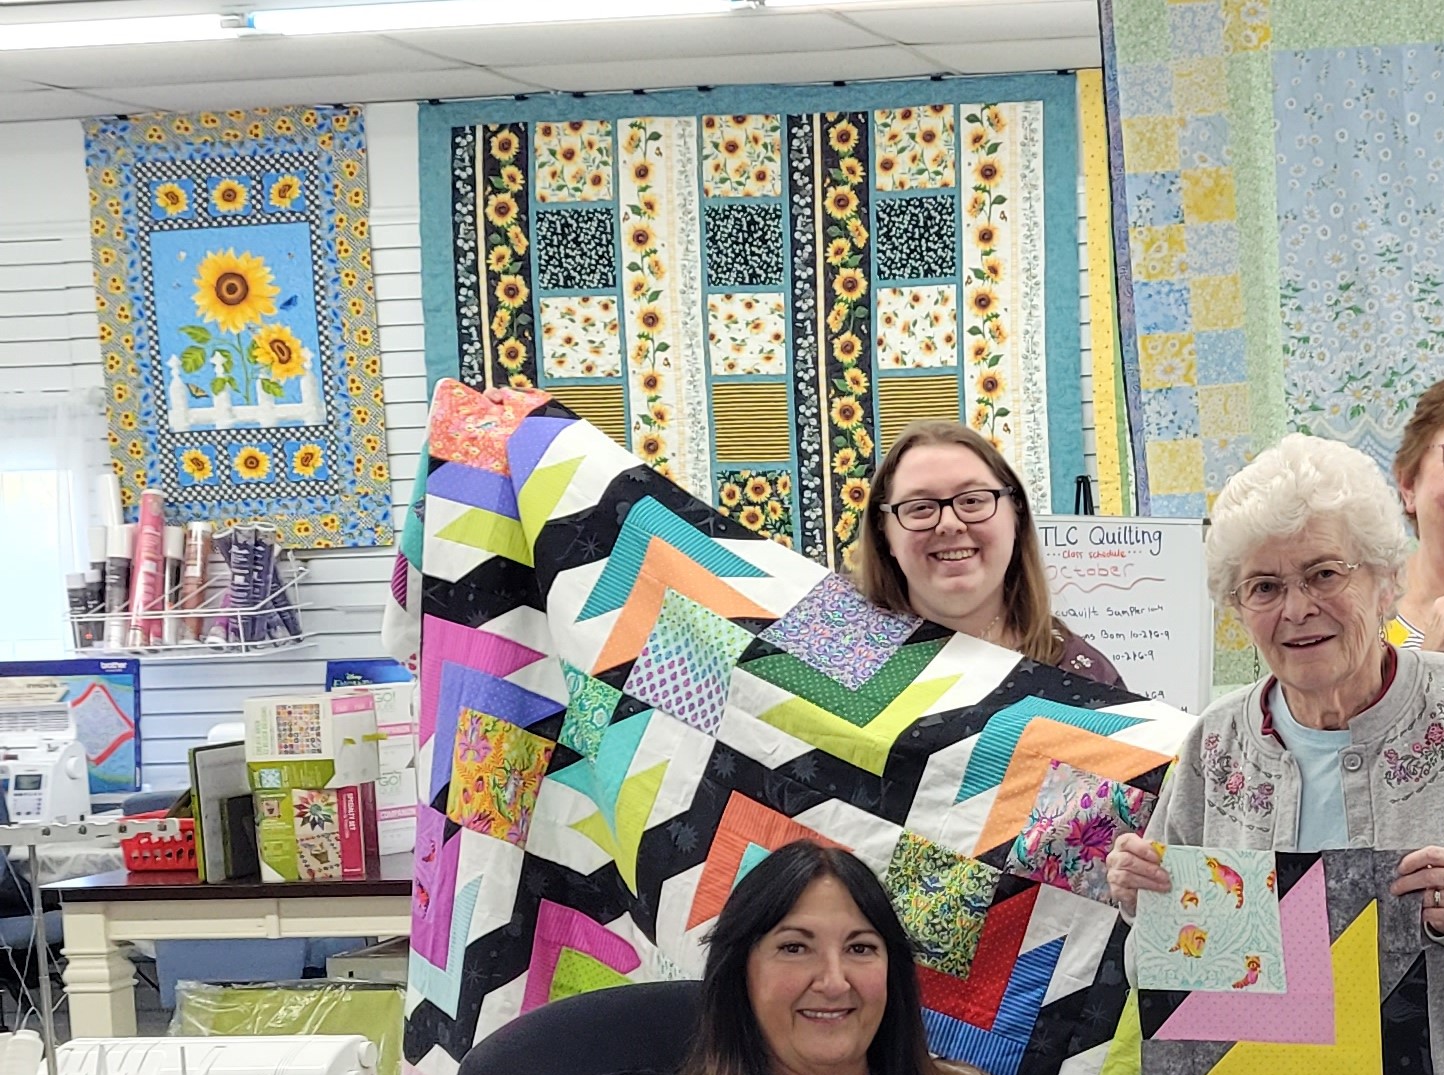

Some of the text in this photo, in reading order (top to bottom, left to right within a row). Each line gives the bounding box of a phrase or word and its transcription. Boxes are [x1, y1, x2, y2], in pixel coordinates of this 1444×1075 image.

[1038, 525, 1162, 556] TLC Quilting
[1088, 549, 1127, 559] schedule
[1054, 606, 1099, 619] cuQuilt
